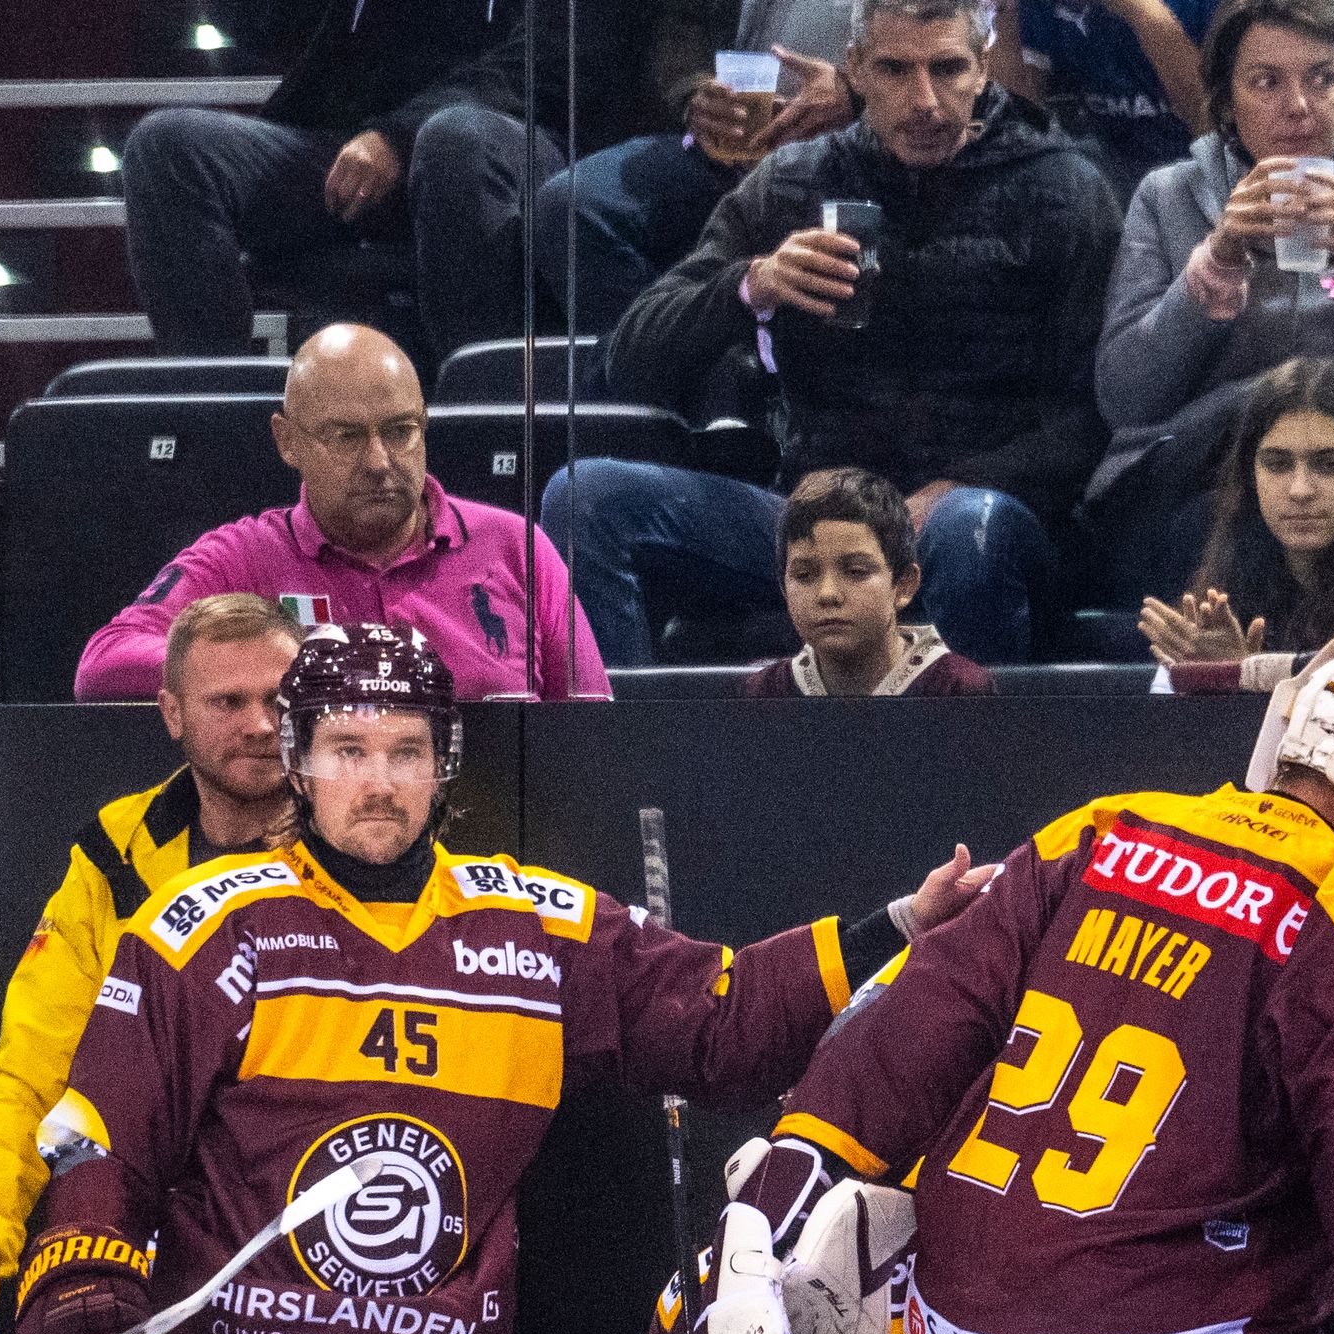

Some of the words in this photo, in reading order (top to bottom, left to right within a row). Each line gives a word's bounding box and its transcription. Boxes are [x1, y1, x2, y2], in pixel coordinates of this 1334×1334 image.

[155, 441, 174, 457] 12
[496, 455, 515, 474] 13
[369, 630, 394, 641] 45
[359, 679, 410, 693] TUDOR
[203, 866, 288, 903] MSC
[1093, 832, 1274, 925] TUDOR
[1066, 909, 1212, 1000] MAYER
[359, 1007, 439, 1078] 45
[946, 989, 1188, 1219] 29
[328, 1123, 452, 1179] GENEVE
[443, 1214, 464, 1234] 05
[307, 1241, 440, 1298] SERVETTE
[806, 1278, 848, 1319] TRUE
